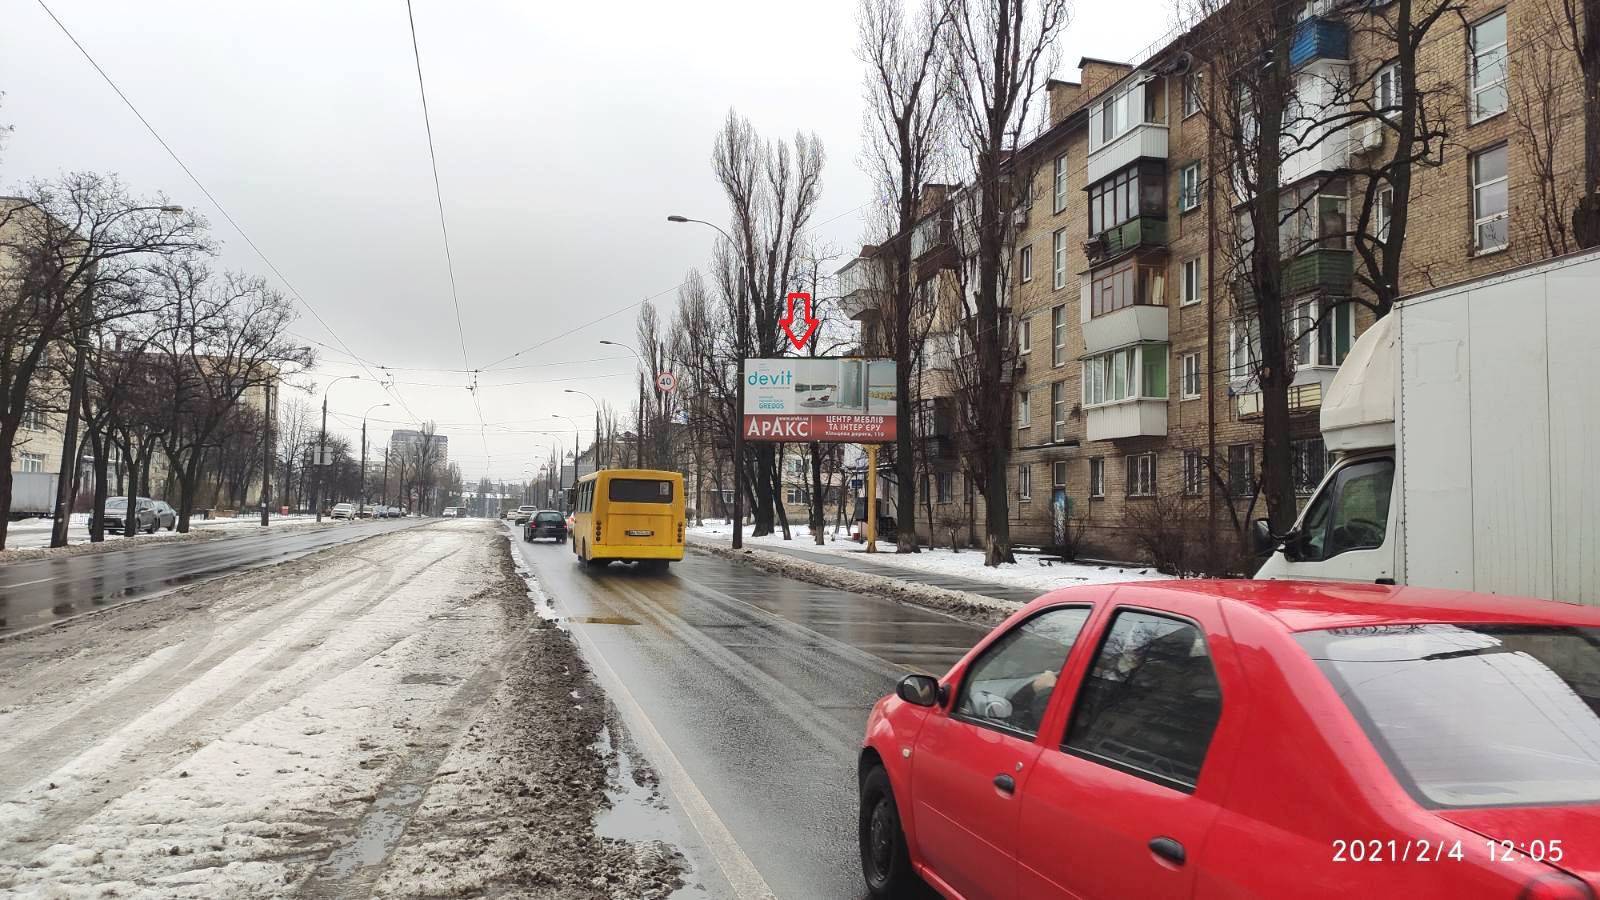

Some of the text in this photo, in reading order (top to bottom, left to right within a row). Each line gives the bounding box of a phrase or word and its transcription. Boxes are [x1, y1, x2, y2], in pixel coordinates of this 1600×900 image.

[660, 377, 672, 386] 40
[748, 370, 793, 386] devit
[825, 415, 884, 424] ЦЕНТР МЕБЛІВ
[828, 423, 839, 431] ТА
